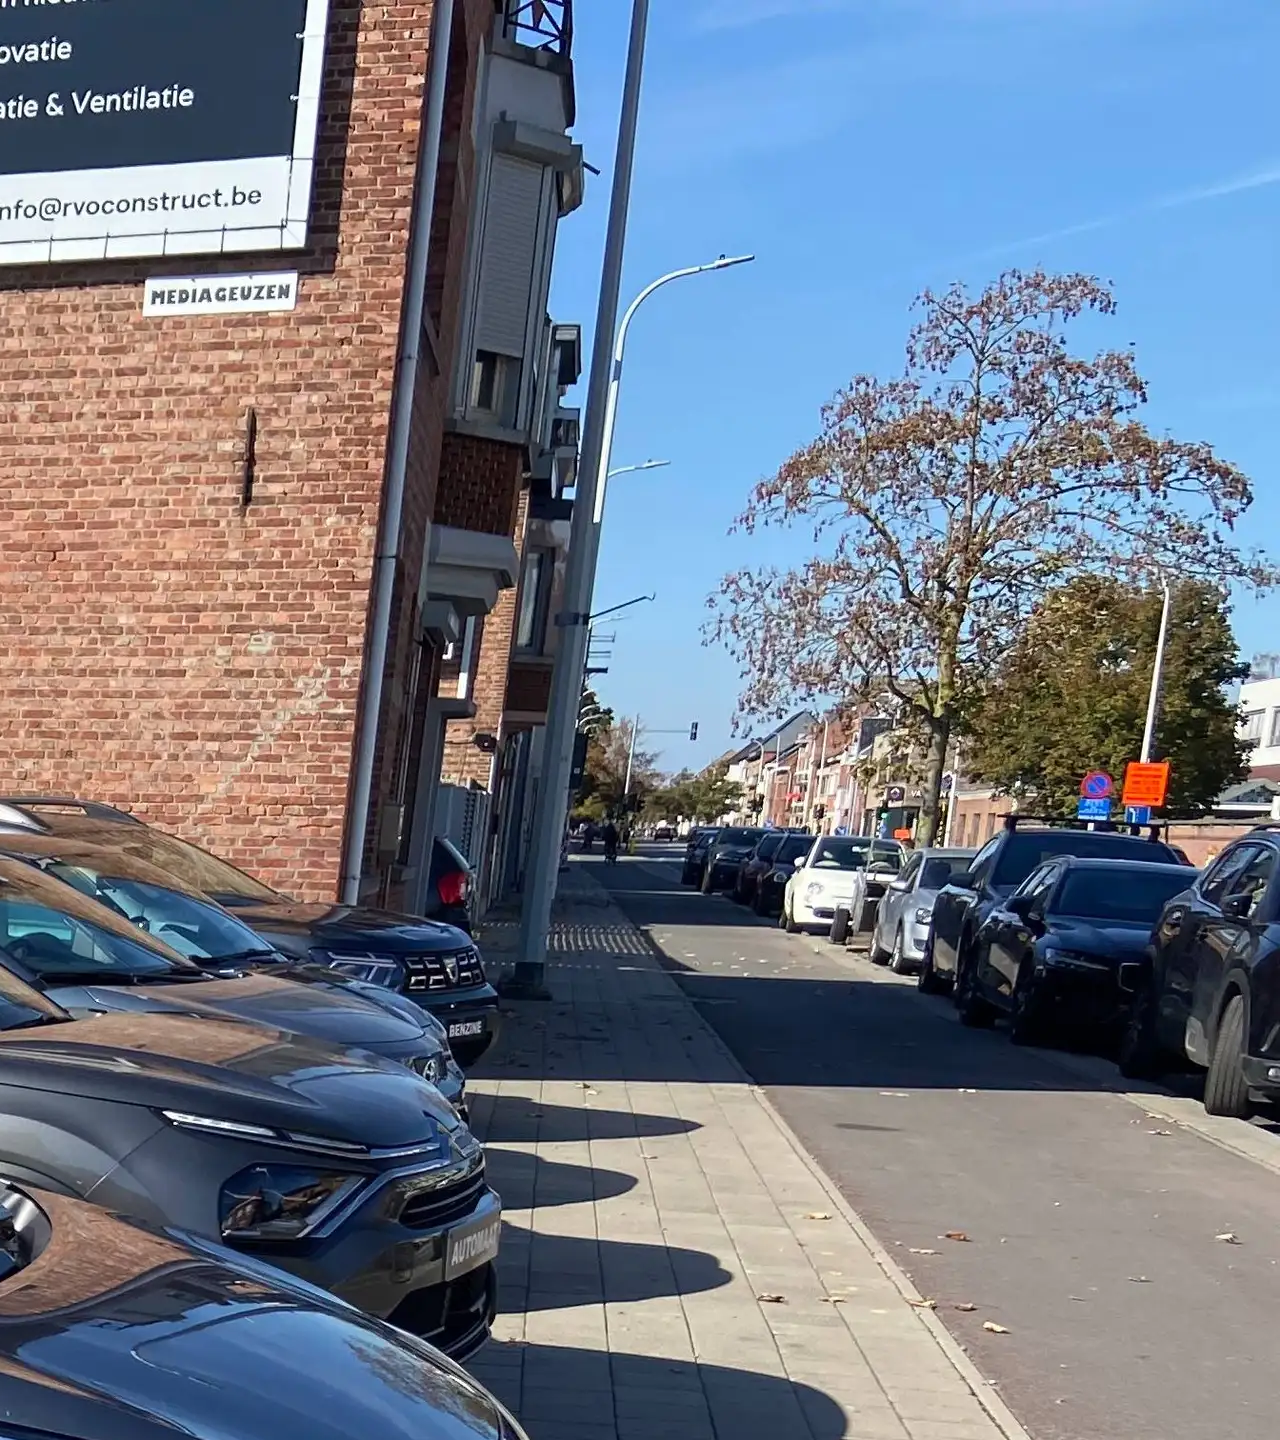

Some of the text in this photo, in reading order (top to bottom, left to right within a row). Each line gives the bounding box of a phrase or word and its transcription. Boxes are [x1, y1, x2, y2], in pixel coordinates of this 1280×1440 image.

[45, 92, 64, 117] &
[71, 83, 195, 115] Ventilatie
[151, 283, 291, 305] MEDIAGEUZEN
